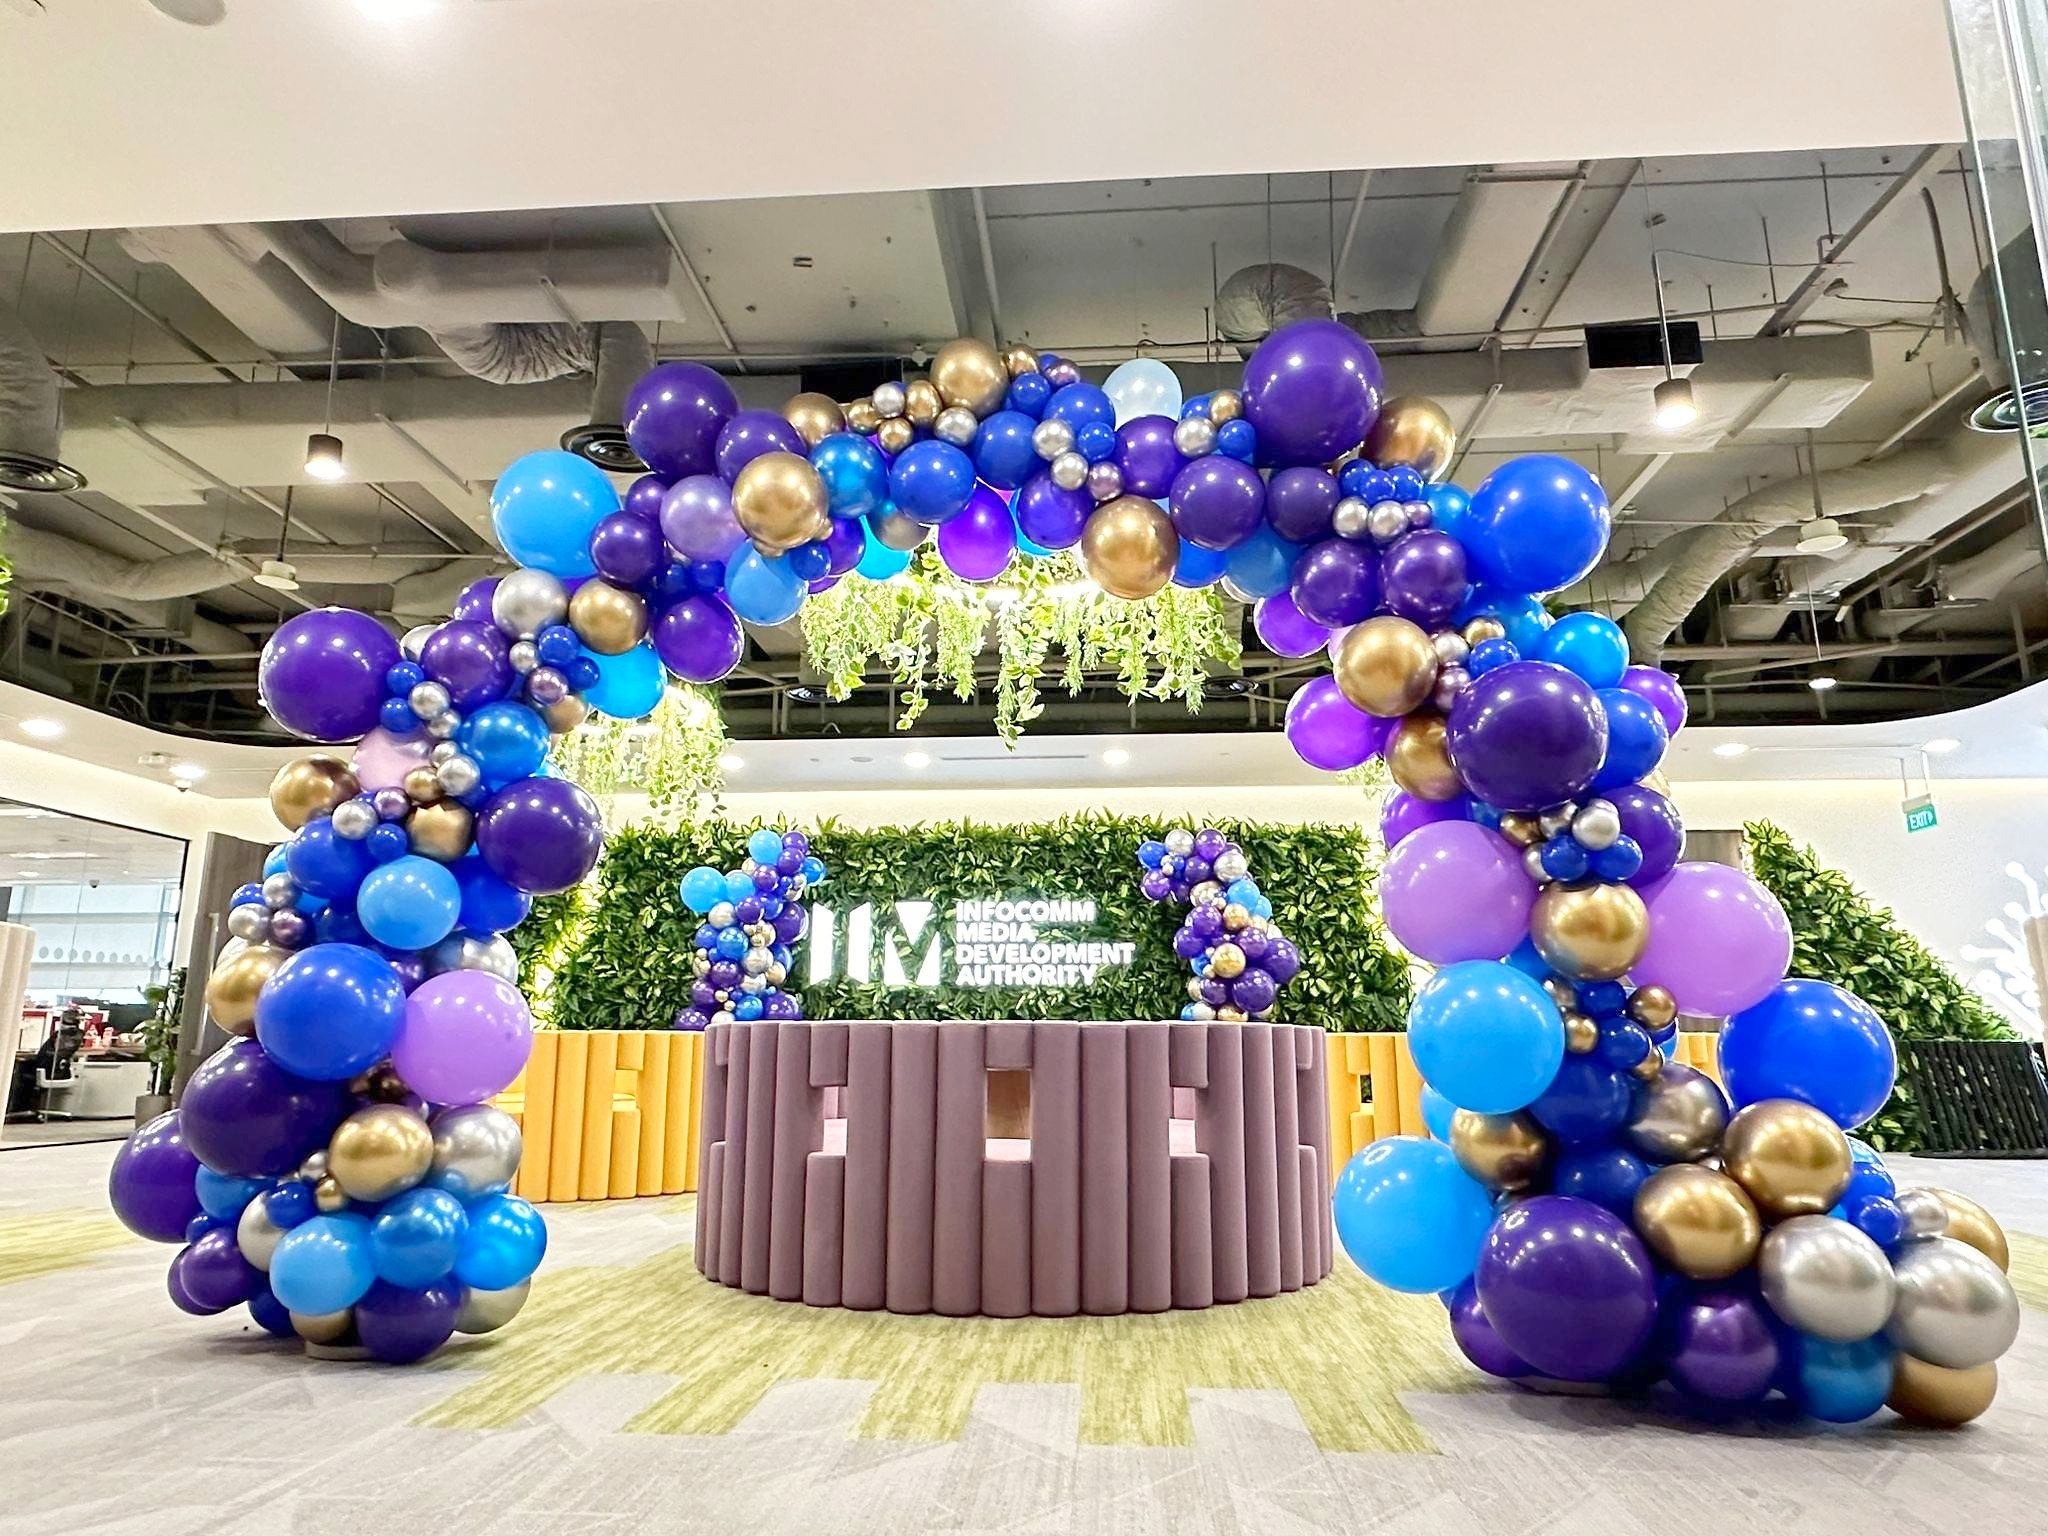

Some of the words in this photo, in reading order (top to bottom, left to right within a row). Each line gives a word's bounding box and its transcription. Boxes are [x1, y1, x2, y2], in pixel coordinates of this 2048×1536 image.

[1909, 811, 1929, 829] EXIT
[955, 900, 1095, 922] INFOCOMM
[955, 922, 1037, 943] MEDIA
[955, 942, 1136, 965] DEVELOPMENT
[955, 963, 1098, 987] AUTHORITY
